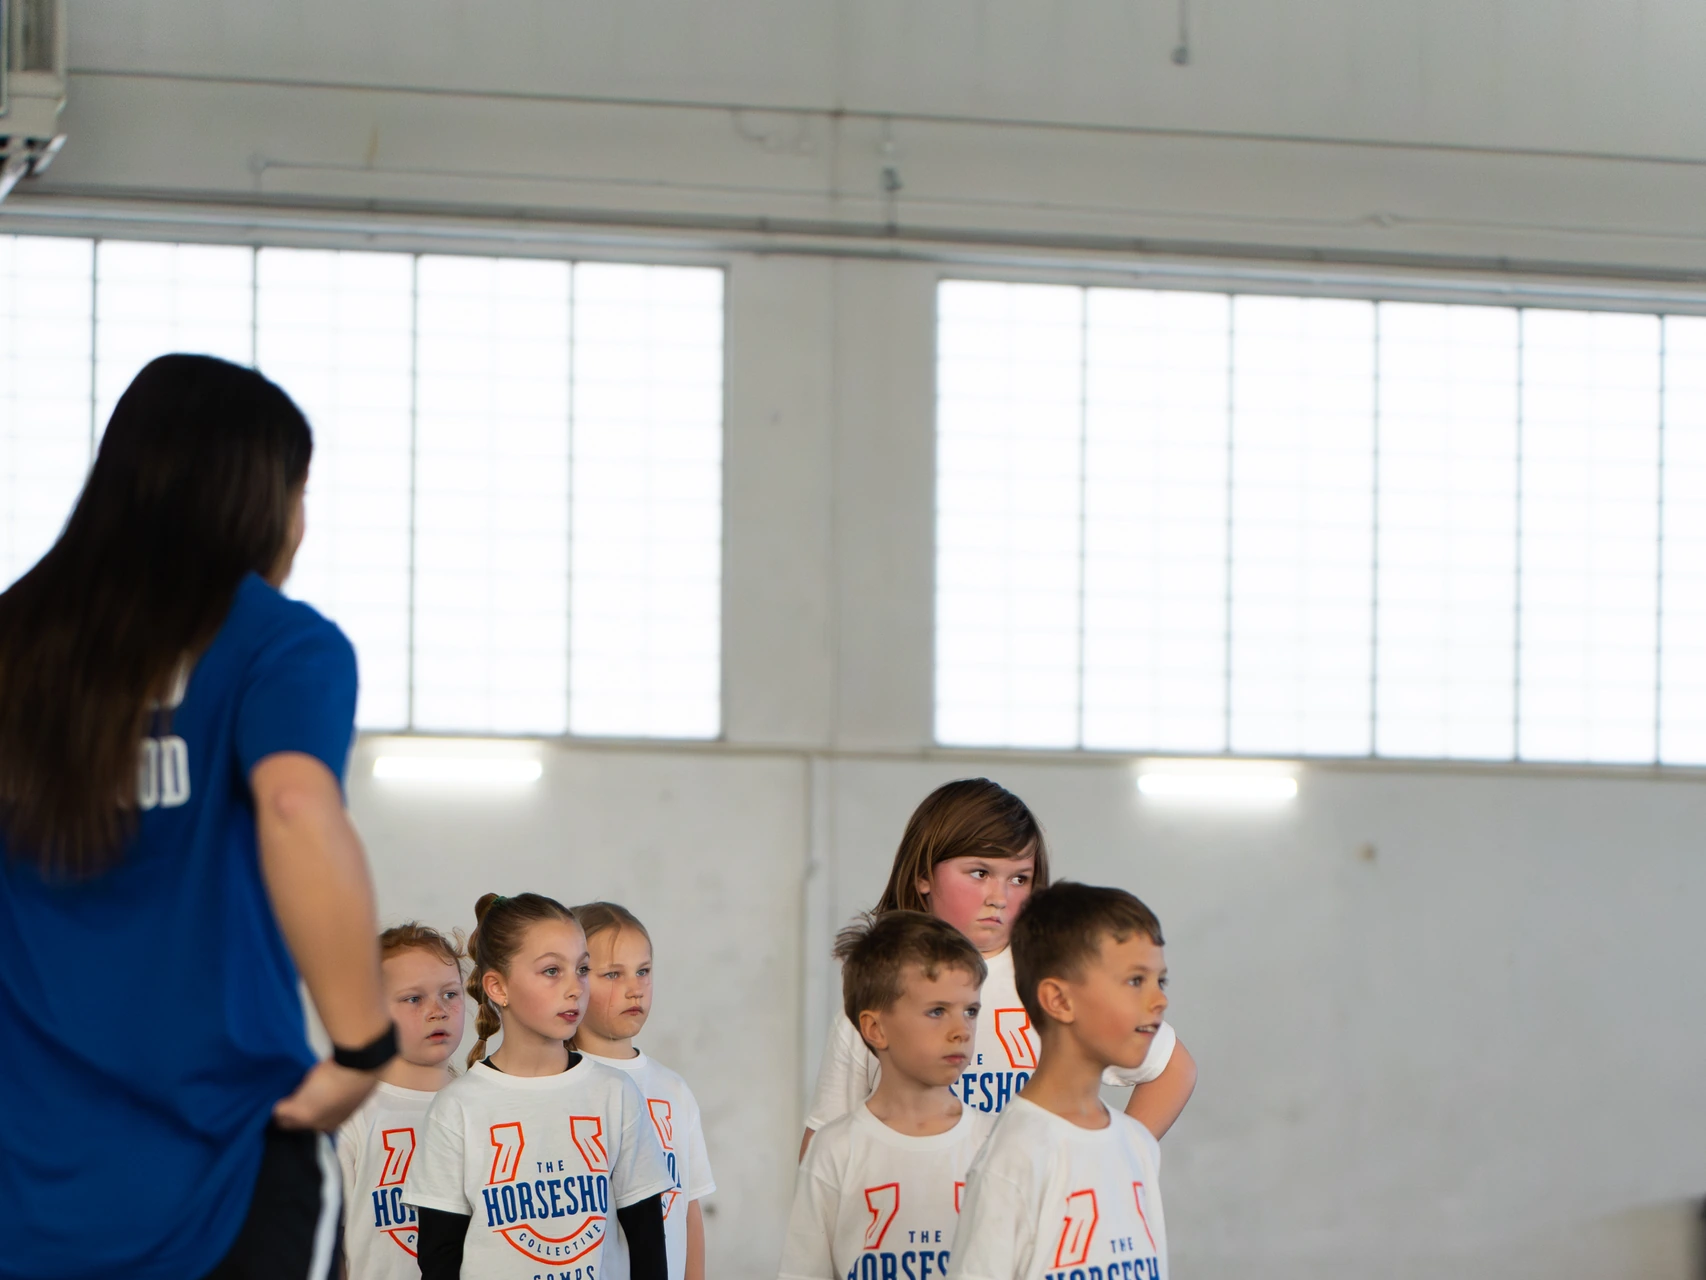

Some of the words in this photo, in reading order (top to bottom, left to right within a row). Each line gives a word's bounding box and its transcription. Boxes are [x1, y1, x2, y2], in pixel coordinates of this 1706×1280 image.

[536, 1160, 564, 1173] THE
[519, 1224, 601, 1256] COLLECTIVE
[908, 1230, 941, 1243] THE
[1110, 1232, 1134, 1254] THE
